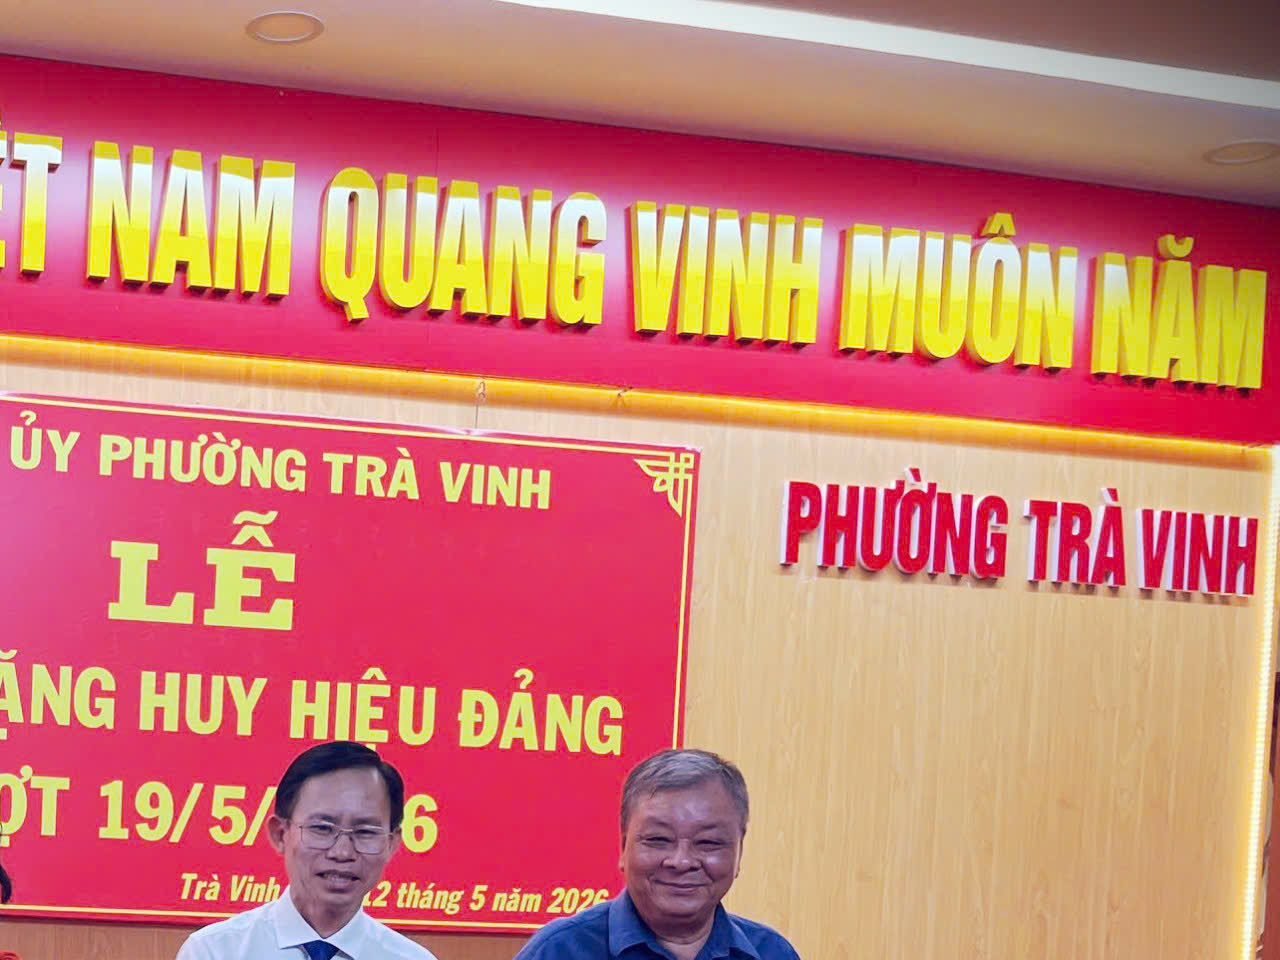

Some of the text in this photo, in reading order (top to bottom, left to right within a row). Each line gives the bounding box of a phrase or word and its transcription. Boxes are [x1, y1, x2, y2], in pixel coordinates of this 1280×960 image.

[86, 140, 296, 299] NAM
[320, 167, 606, 327] QUANG
[629, 200, 822, 345] VINH
[838, 212, 1078, 372] MUÔN
[1090, 235, 1267, 390] NĂM
[10, 410, 80, 472] ỦY
[98, 432, 306, 493] PHƯỜNG
[322, 445, 419, 500] TRÀ
[440, 461, 551, 510] VINH
[108, 510, 296, 631] LỄ
[780, 467, 1259, 597] PHƯỜNG TRÀ VINH
[139, 670, 268, 736] HUY
[289, 667, 437, 752] HIỆU
[458, 668, 624, 756] ĐẢNG
[180, 873, 221, 902] Trà
[397, 882, 465, 916] tháng
[469, 884, 489, 911] 5
[491, 887, 543, 913] năm
